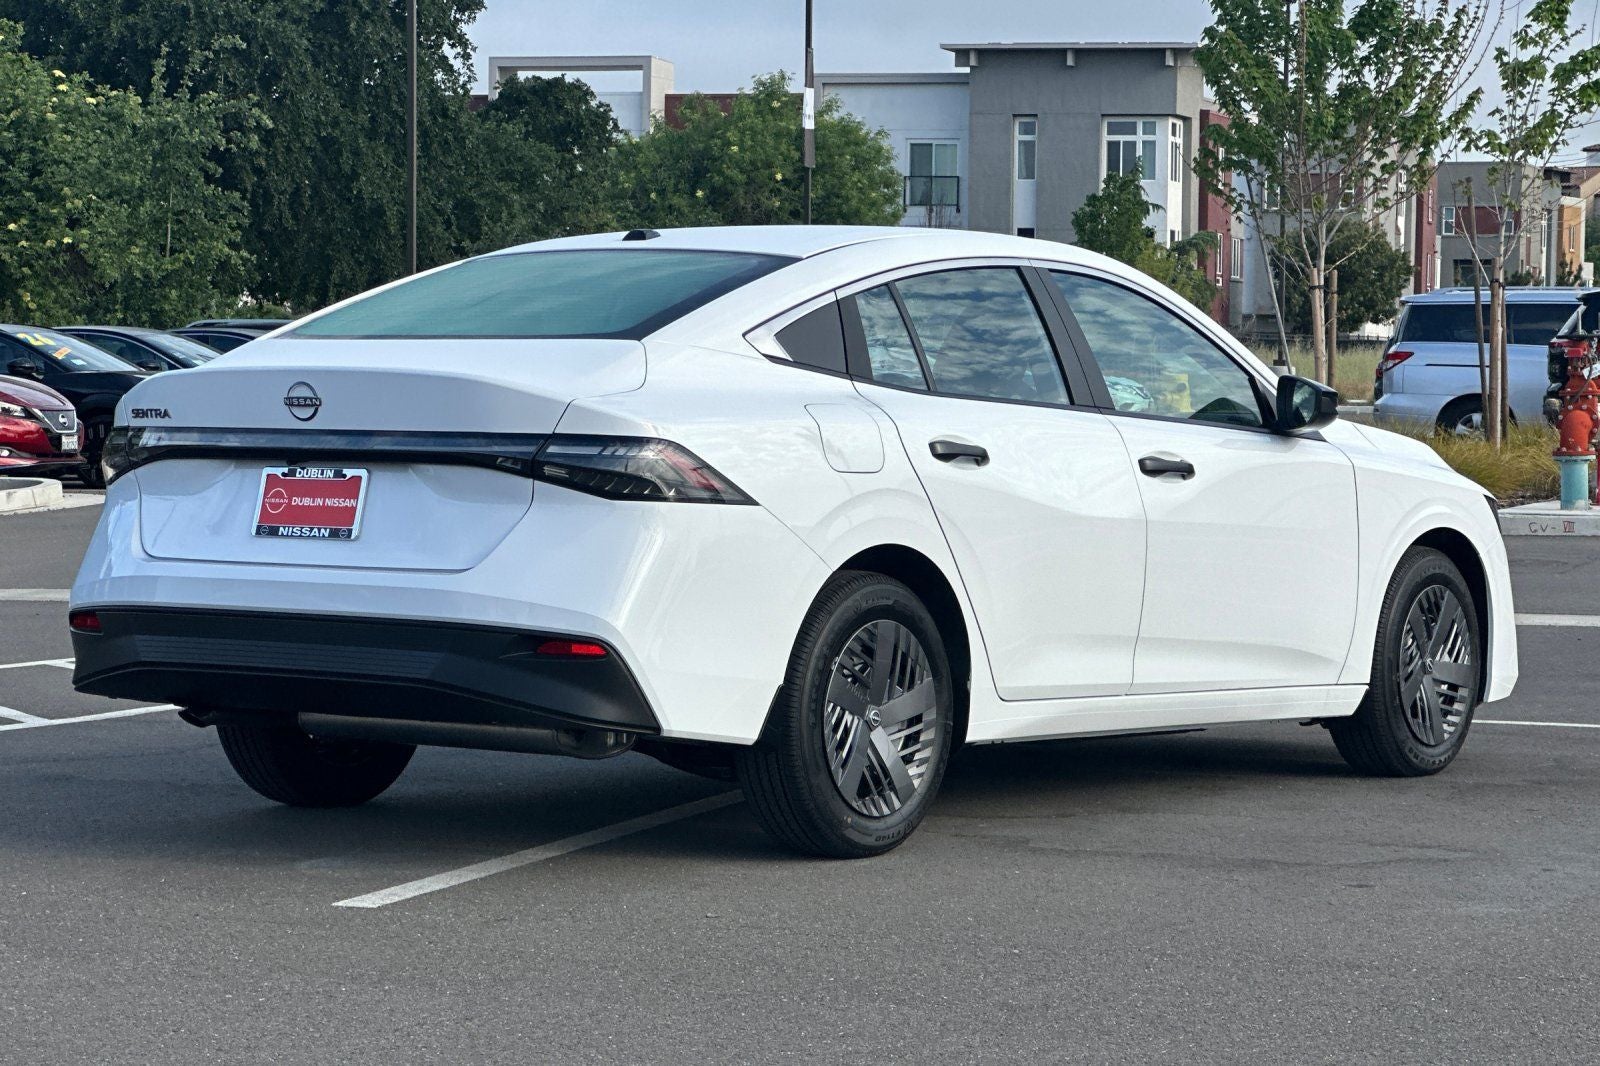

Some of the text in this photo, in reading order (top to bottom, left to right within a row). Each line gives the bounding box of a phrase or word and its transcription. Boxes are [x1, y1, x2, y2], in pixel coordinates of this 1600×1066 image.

[284, 397, 321, 406] NISSAN
[131, 408, 171, 419] SENTRA
[296, 468, 334, 478] DUBLIN
[291, 496, 357, 508] DUBLIN NISSAN
[278, 526, 330, 538] NISSAN
